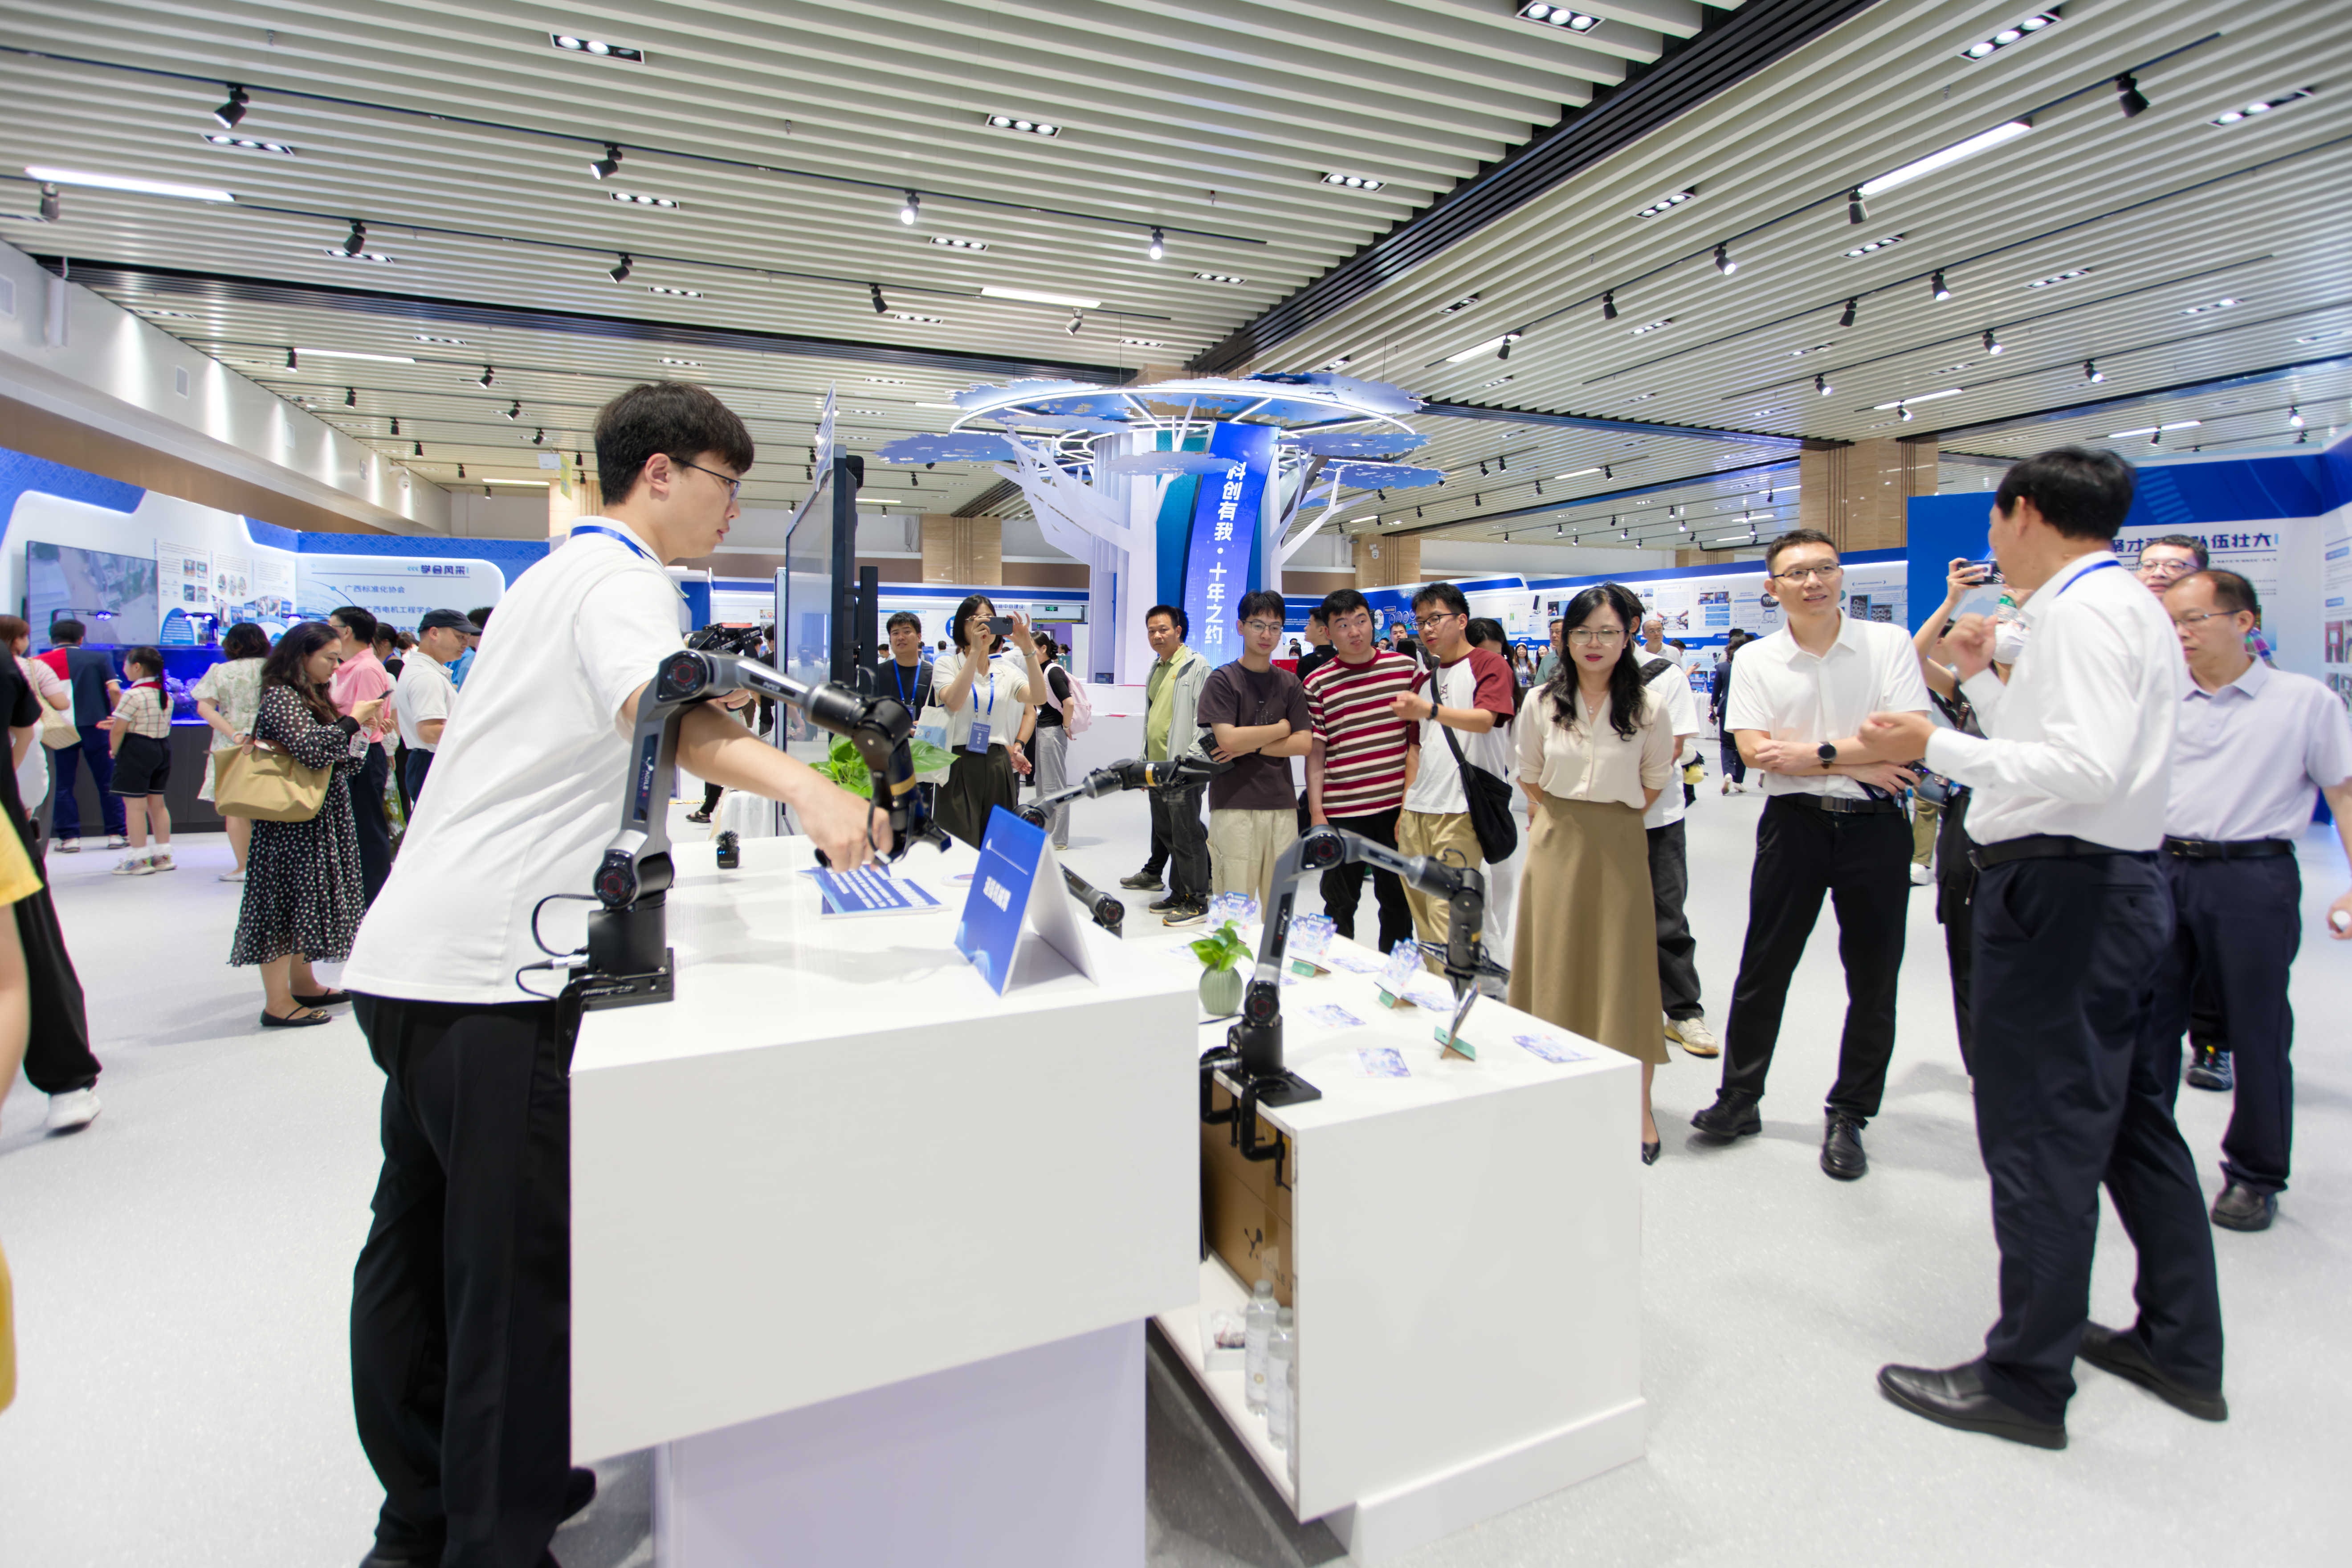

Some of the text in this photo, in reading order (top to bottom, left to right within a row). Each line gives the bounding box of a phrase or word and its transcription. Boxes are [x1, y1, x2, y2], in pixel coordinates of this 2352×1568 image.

[1205, 462, 1247, 644] 科创有我·十年之约
[420, 565, 466, 575] 学会风采
[345, 585, 406, 594] 广西标准化协会
